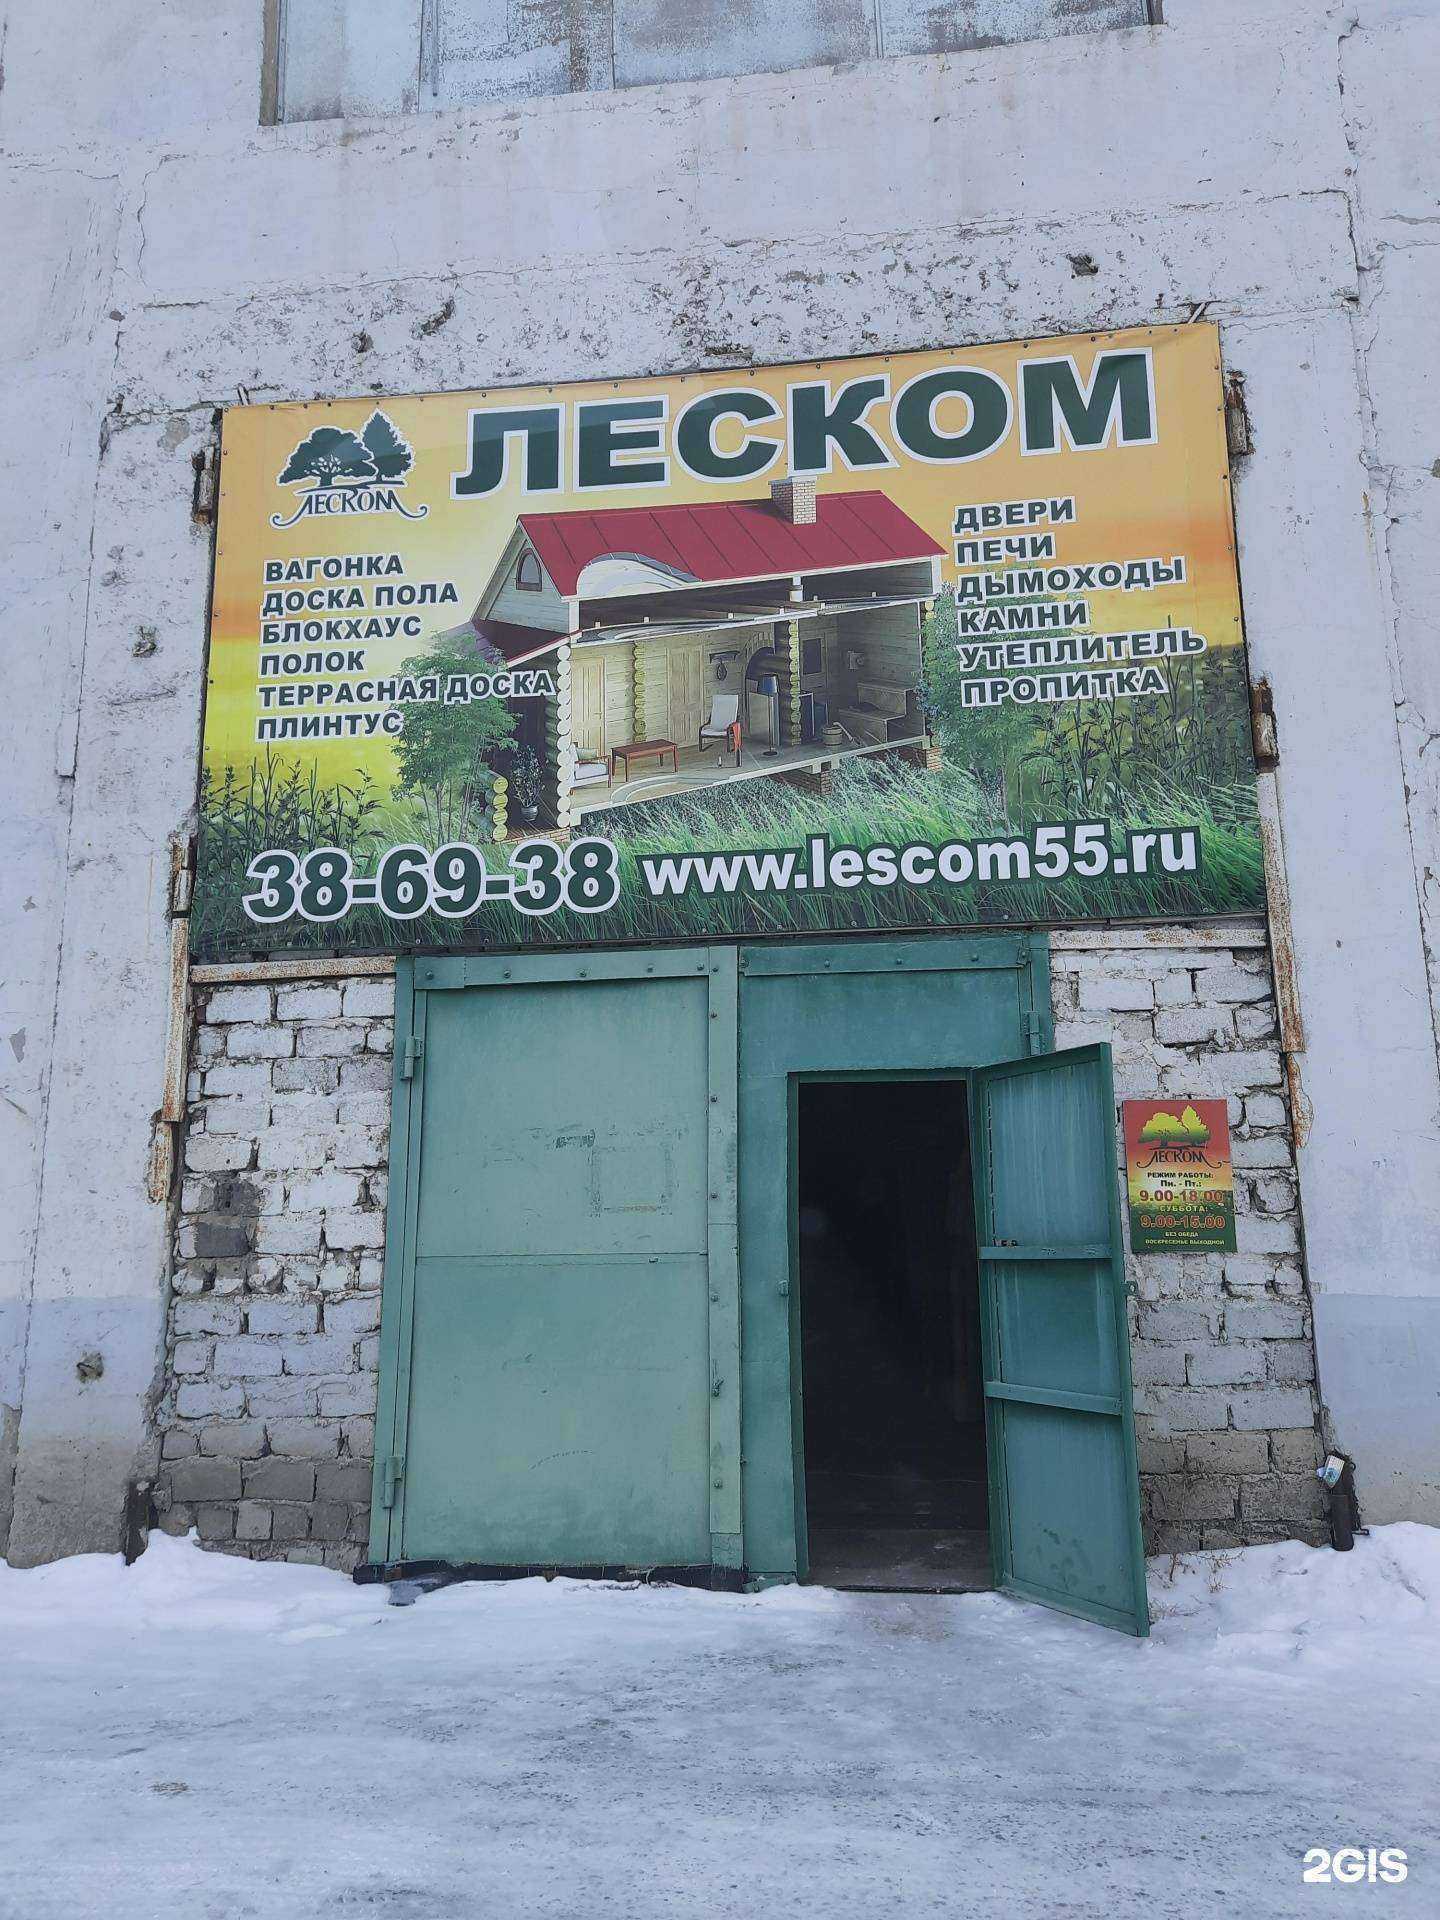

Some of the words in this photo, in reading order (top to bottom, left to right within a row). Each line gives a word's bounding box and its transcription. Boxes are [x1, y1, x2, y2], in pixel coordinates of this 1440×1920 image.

[451, 348, 1157, 498] ЛЕСКОМ
[271, 490, 427, 528] ЛЕСКОМ
[954, 498, 1074, 532] ДВЕРИ
[956, 535, 1054, 564] ПЕЧИ
[264, 554, 404, 582] ВАГОНКА
[957, 557, 1184, 602] ДЫМОХОДЫ
[262, 588, 364, 617] ДОСКА
[375, 582, 459, 605] ПОЛА
[262, 615, 423, 644] БЛОКХАУС
[959, 602, 1088, 633] КАМНИ
[260, 650, 365, 675] ПОЛОК
[958, 629, 1206, 670] УТЕПЛИТЕЛЬ
[258, 677, 443, 708] ТЕРРАСНАЯ
[446, 670, 554, 702] ДОСКА
[962, 669, 1167, 706] ПРОПИТКА
[257, 712, 402, 740] ПЛИНТУС
[243, 838, 620, 922] 38-69-38
[642, 824, 1197, 895] www.lescom55.ru
[1137, 1150, 1222, 1168] ЛЕСКОМ
[1139, 1189, 1224, 1202] 9.00-18.00
[1140, 1215, 1225, 1229] 9.00-15.00
